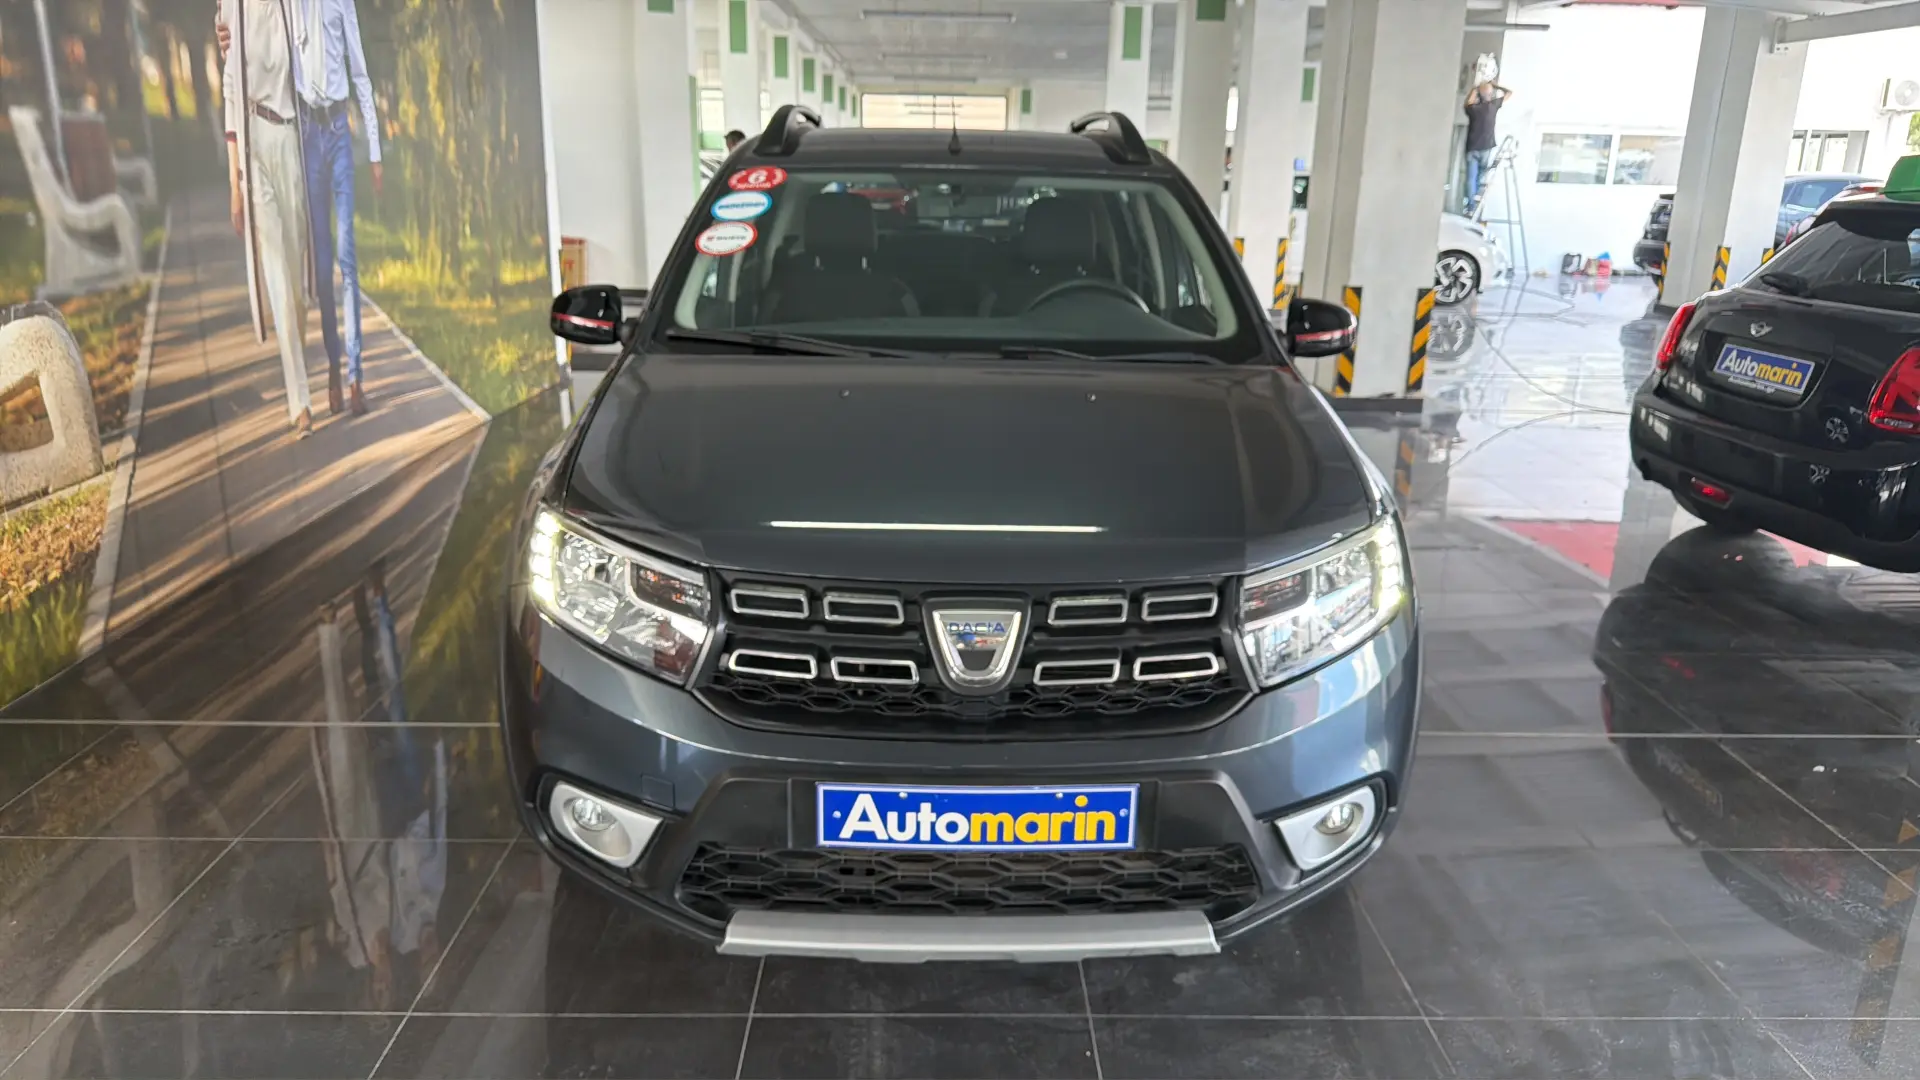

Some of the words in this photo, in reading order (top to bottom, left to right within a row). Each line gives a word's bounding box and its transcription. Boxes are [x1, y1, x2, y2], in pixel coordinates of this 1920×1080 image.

[748, 169, 769, 184] 6
[1721, 348, 1803, 388] Automarin
[949, 622, 1005, 633] DACIA
[839, 793, 1116, 843] Automarin
